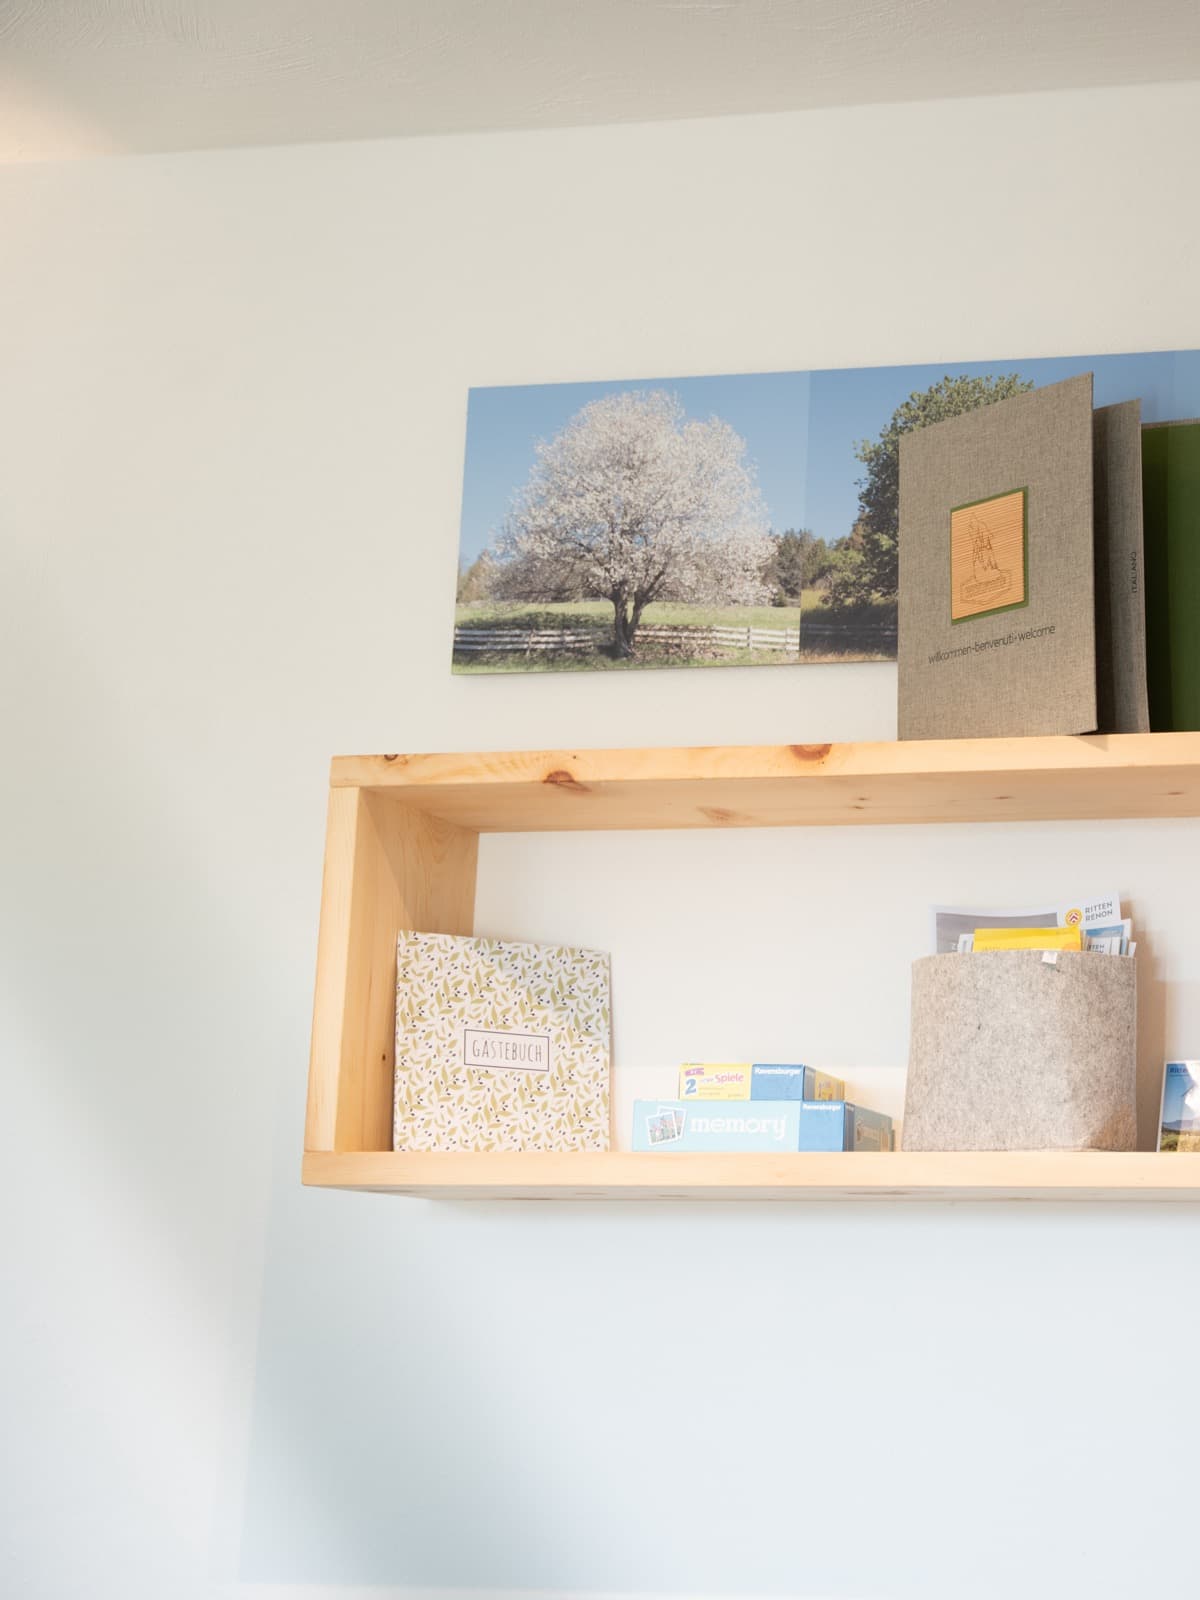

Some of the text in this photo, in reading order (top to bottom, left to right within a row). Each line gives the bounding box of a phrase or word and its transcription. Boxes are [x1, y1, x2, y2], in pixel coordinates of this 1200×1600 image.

[1084, 901, 1113, 914] RITTEN
[1084, 909, 1113, 922] RENON
[714, 1073, 744, 1085] Spiele
[684, 1079, 697, 1095] 2
[690, 1115, 787, 1140] memory
